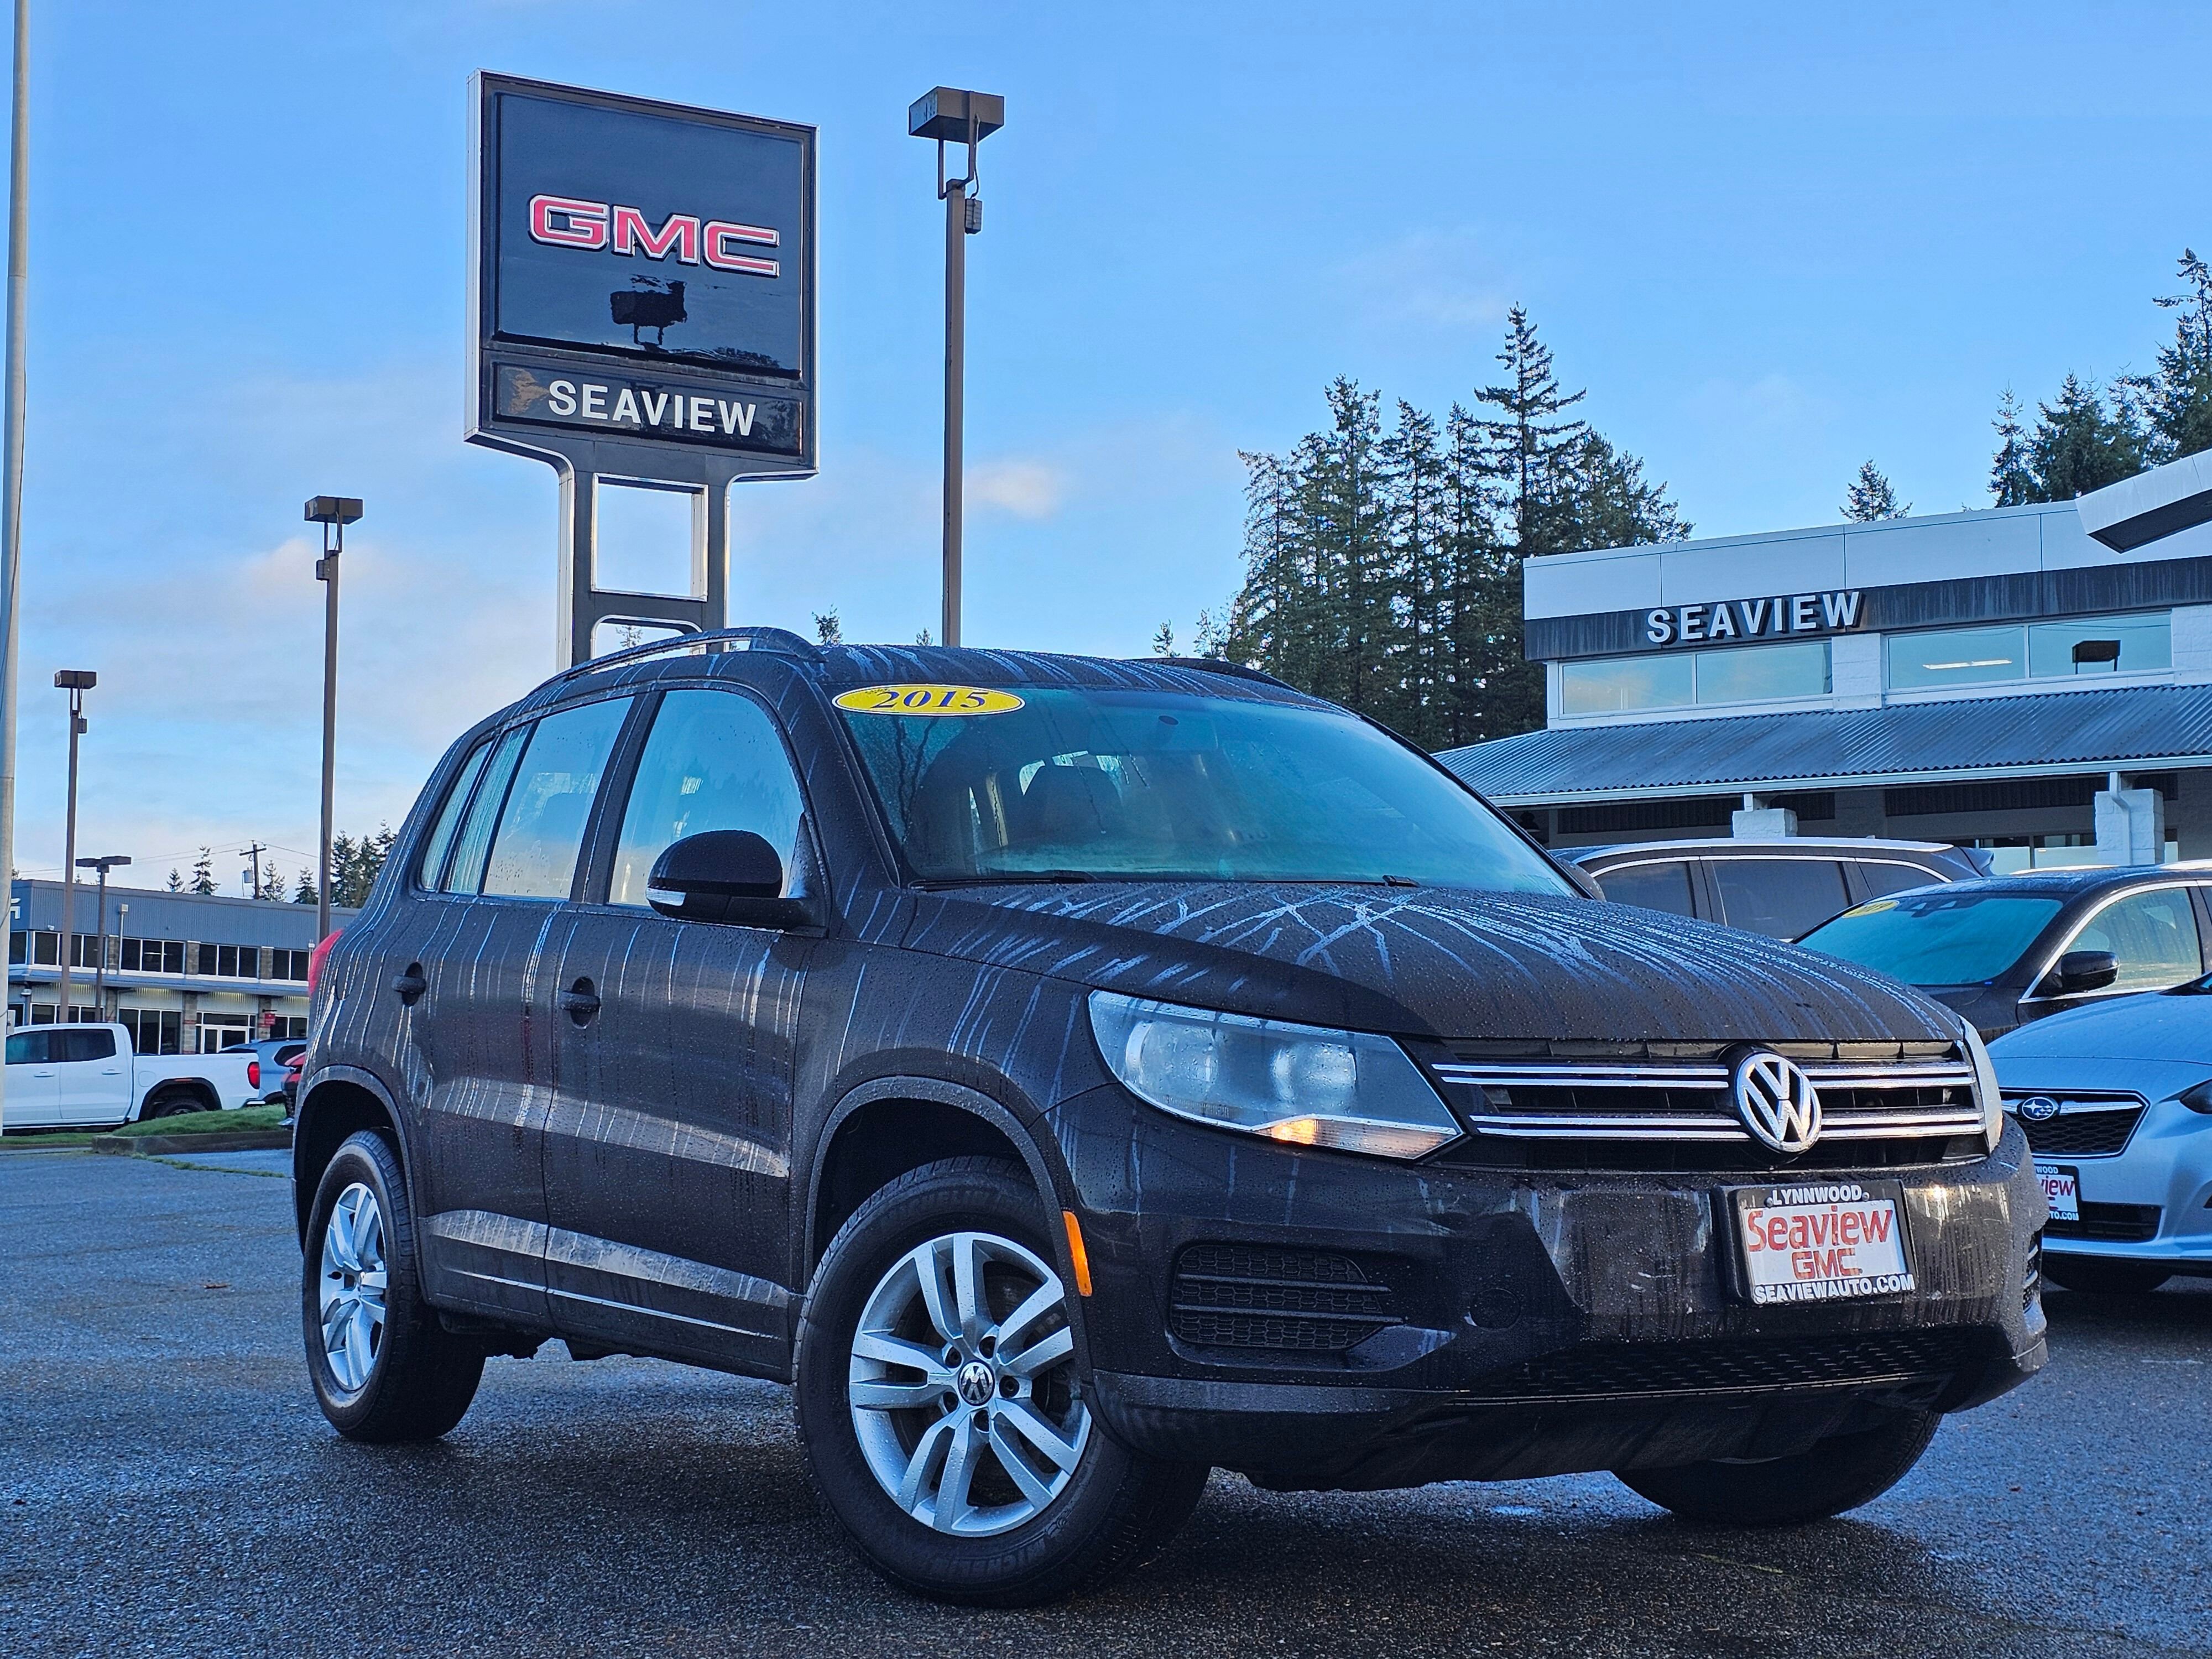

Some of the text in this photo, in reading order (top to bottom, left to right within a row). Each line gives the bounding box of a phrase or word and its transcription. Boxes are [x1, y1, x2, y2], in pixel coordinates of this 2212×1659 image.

[529, 194, 780, 278] GMC
[548, 380, 757, 436] SEAVIEW
[1647, 591, 1860, 643] SEAVIEW
[870, 690, 989, 708] 2015
[2035, 1166, 2059, 1174] WOOD
[1772, 1185, 1862, 1206] LYNNWOOD
[1747, 1205, 1893, 1253] Seaview
[1791, 1248, 1860, 1280] GMC
[1754, 1274, 1916, 1304] SEAVIEWAUTO.COM
